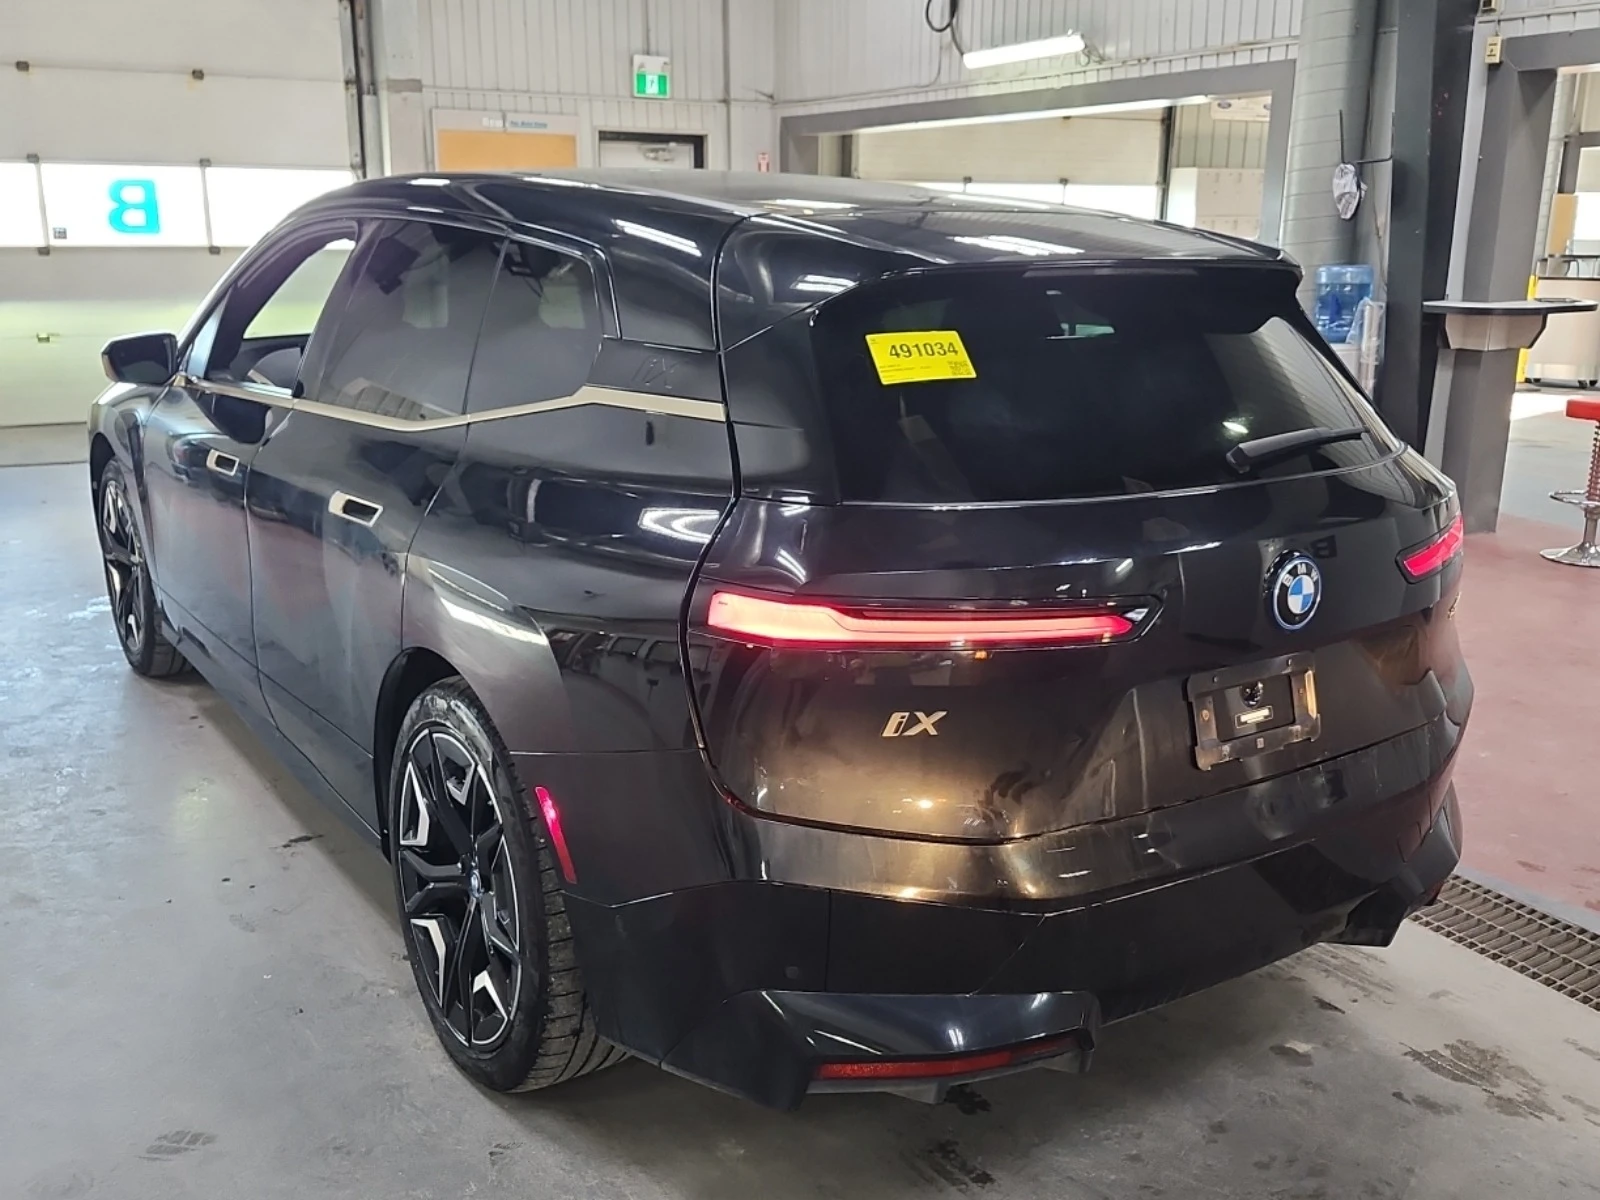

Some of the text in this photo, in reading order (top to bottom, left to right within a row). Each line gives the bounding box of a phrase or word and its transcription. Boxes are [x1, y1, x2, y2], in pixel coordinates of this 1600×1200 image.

[889, 341, 959, 359] 491034
[1282, 562, 1320, 588] BMW
[881, 710, 948, 737] iX
